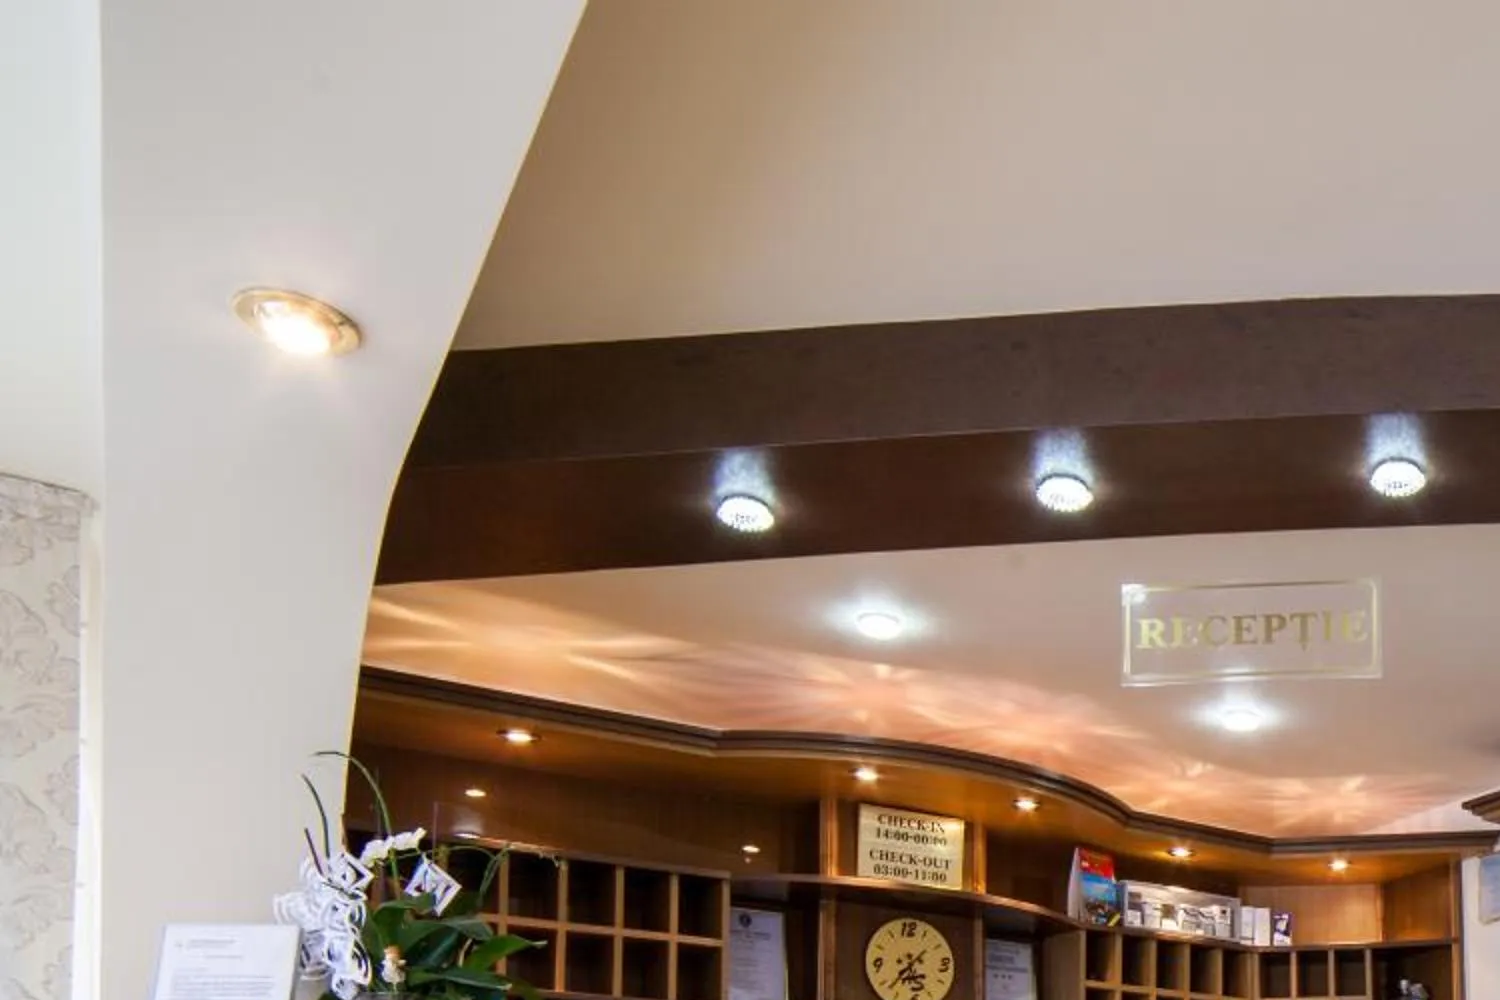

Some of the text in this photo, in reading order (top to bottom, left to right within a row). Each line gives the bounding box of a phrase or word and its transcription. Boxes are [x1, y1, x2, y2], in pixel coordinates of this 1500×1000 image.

[878, 814, 945, 833] CHECK-IN
[869, 849, 951, 870] CHECK-OUT
[901, 922, 917, 937] 12
[873, 957, 883, 973] 9
[938, 957, 950, 973] 3
